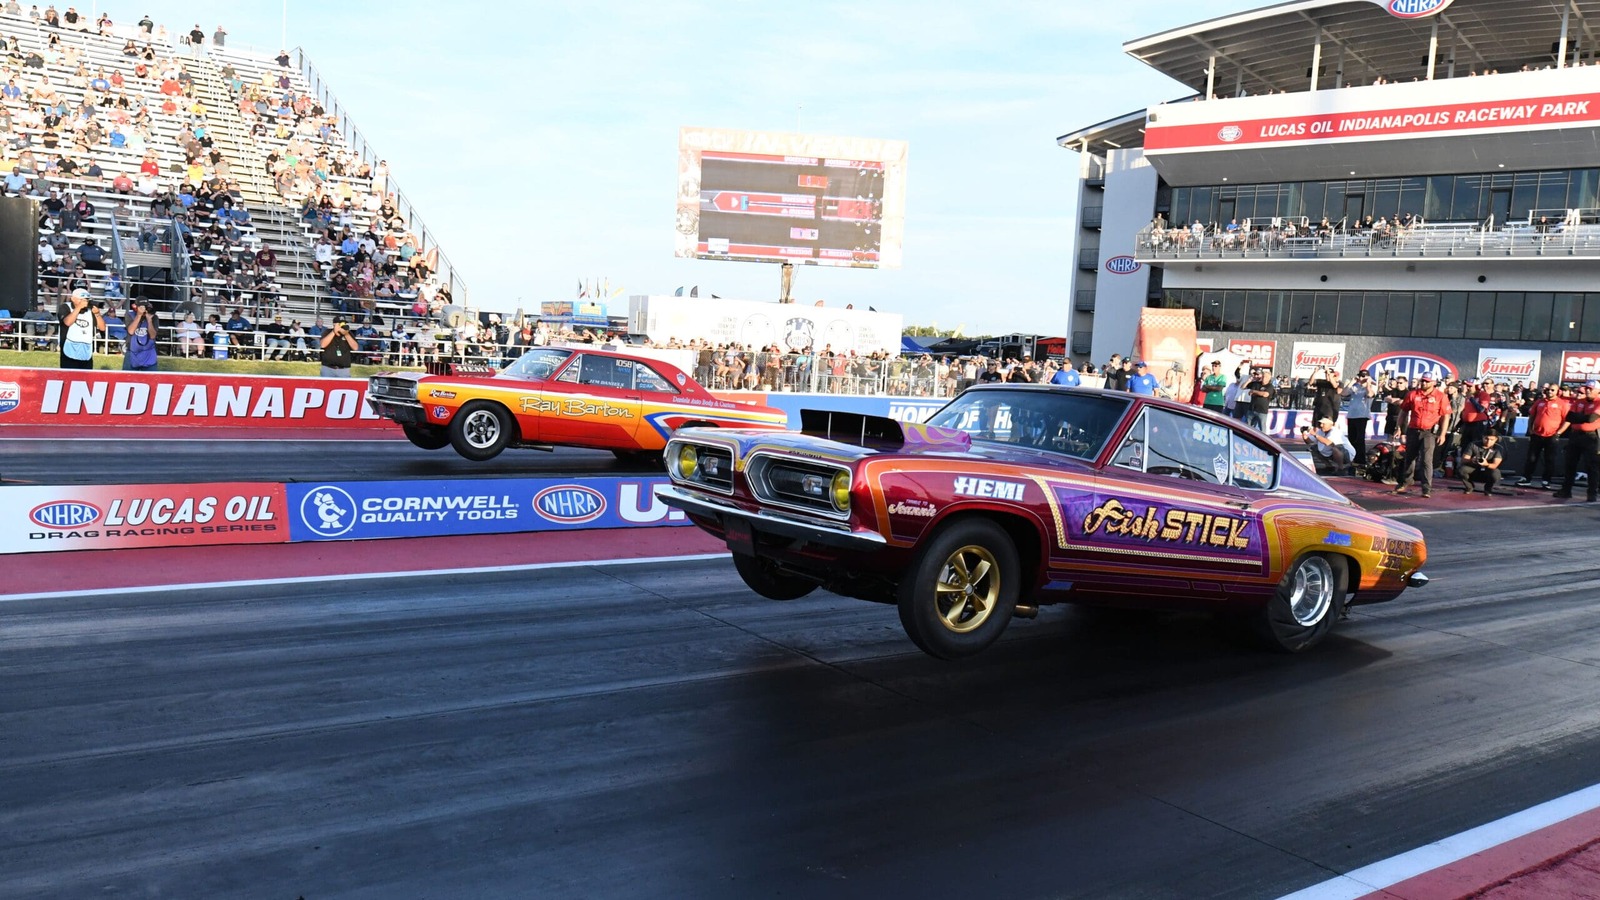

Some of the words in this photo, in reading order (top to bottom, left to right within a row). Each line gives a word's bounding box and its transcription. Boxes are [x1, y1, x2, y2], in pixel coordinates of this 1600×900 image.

[1397, 0, 1439, 13] NHRA
[1260, 122, 1305, 137] LUCAS
[1310, 120, 1334, 134] OIL
[1338, 111, 1450, 132] INDIANAPOLIS
[1454, 104, 1538, 123] RACEWAY
[1540, 101, 1590, 117] PARK
[1110, 258, 1136, 271] NHRA
[519, 396, 560, 416] Ray
[562, 398, 634, 418] Barton
[953, 476, 1026, 501] HEMI
[40, 504, 95, 525] NHRA
[104, 497, 219, 527] LUCAS
[224, 496, 275, 521] OIL
[362, 495, 517, 511] CORNWELL
[544, 491, 598, 517] NHRA
[888, 501, 937, 517] Jeannie
[361, 510, 445, 523] QUALITY
[457, 508, 518, 521] TOOLS
[1083, 497, 1161, 541] Fish
[1161, 509, 1249, 550] STICK
[29, 529, 100, 540] DRAG
[105, 526, 195, 538] RACING
[200, 523, 277, 534] SERIES
